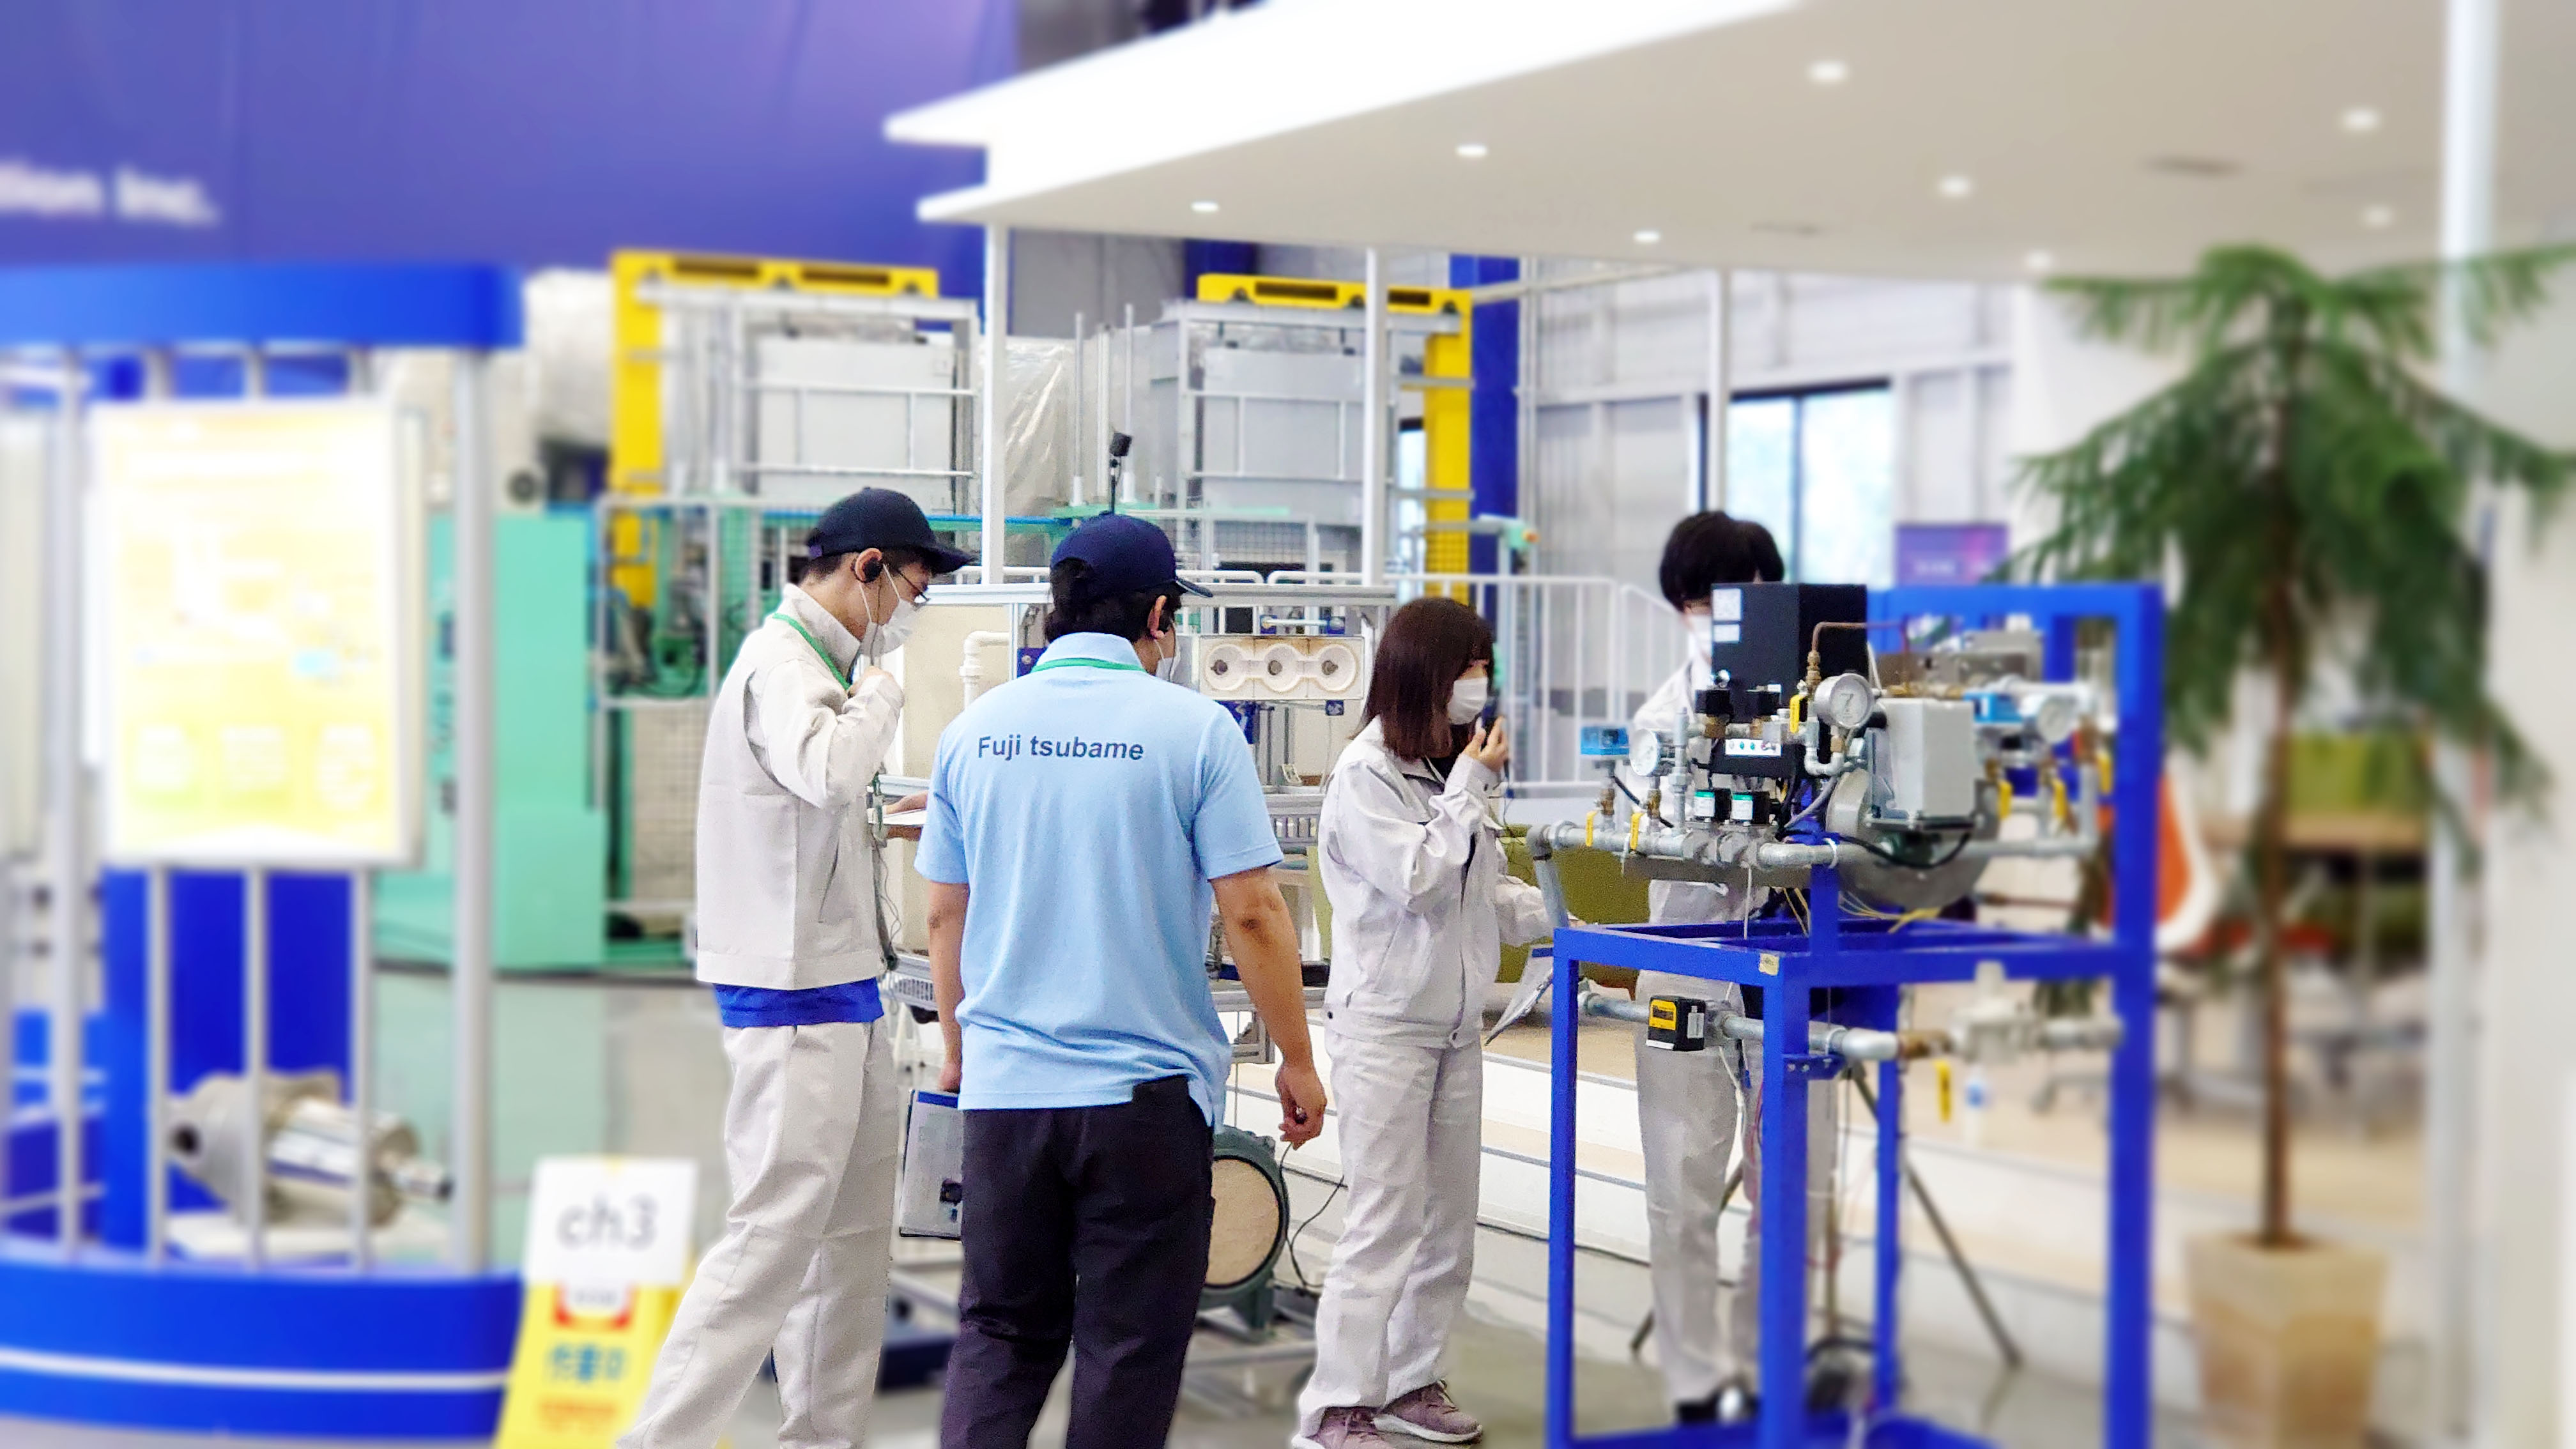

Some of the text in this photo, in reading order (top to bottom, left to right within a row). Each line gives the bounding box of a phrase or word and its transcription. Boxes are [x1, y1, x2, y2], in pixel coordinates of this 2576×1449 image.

[977, 734, 1144, 761] Fuji tsubame
[557, 1193, 658, 1250] ch3
